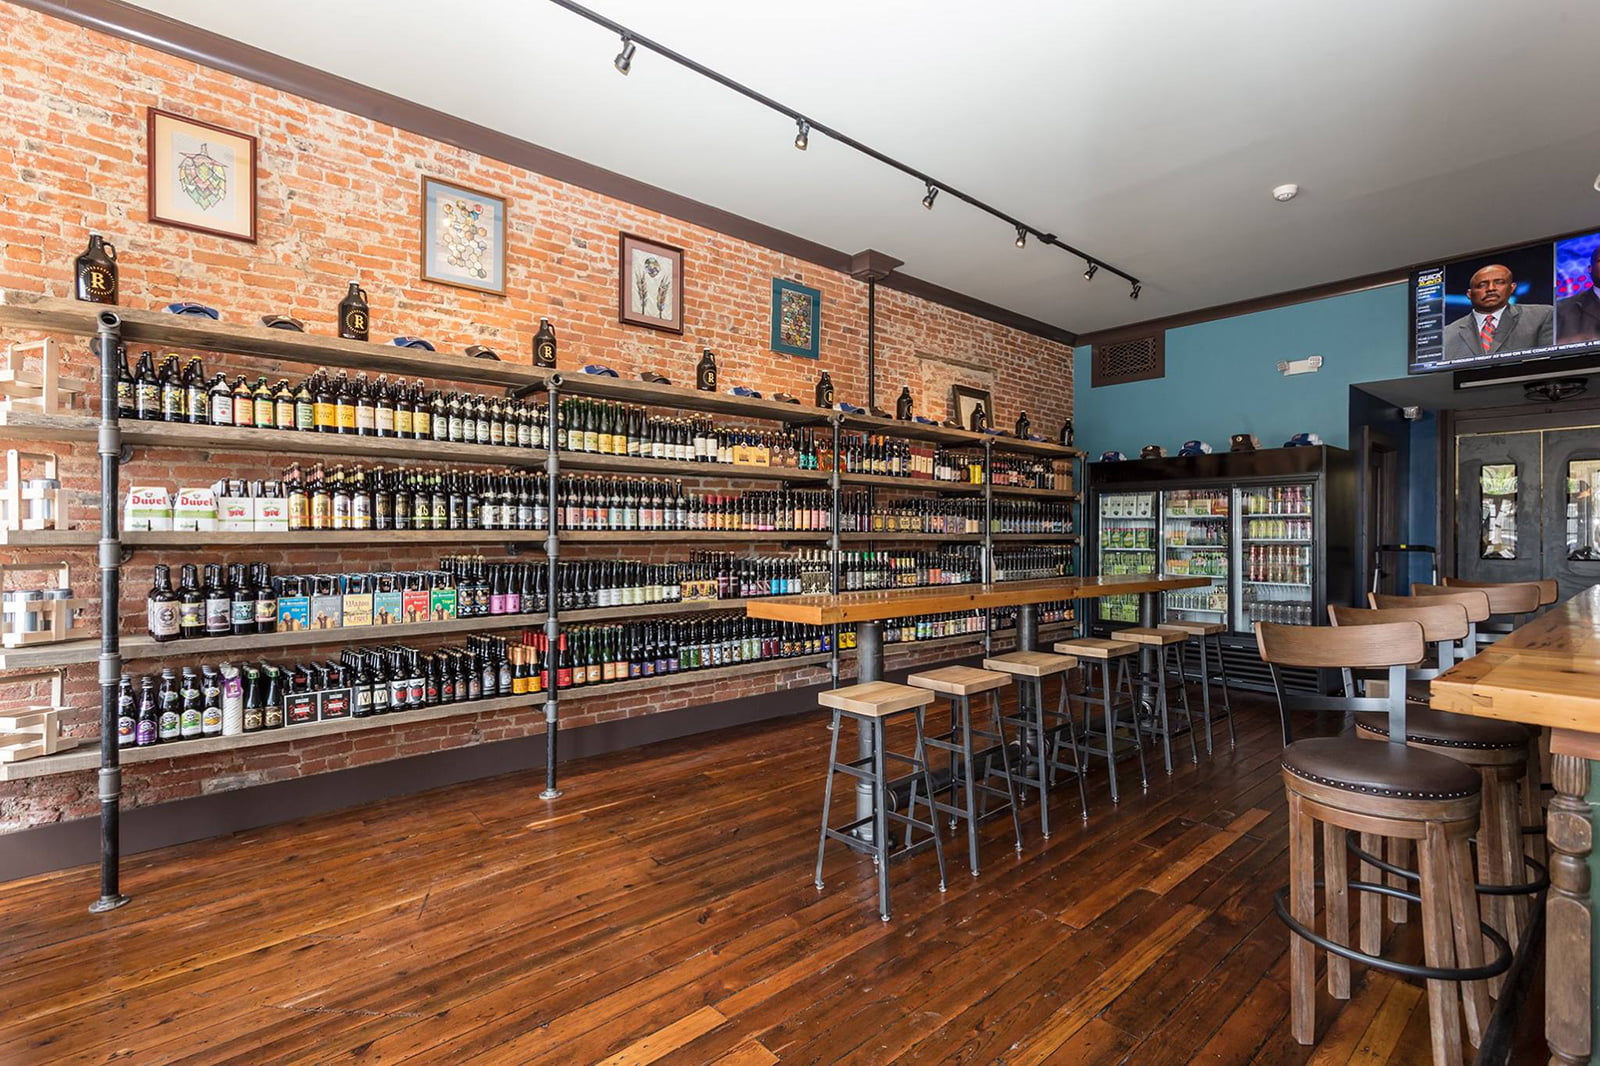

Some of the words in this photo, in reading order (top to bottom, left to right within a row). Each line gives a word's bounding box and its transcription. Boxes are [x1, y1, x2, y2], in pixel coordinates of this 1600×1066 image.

[90, 271, 105, 290] R
[1418, 271, 1443, 282] QUICK
[354, 314, 364, 329] R
[1532, 346, 1558, 354] COMCAST
[132, 495, 166, 505] Duvel
[181, 496, 213, 506] Duvel
